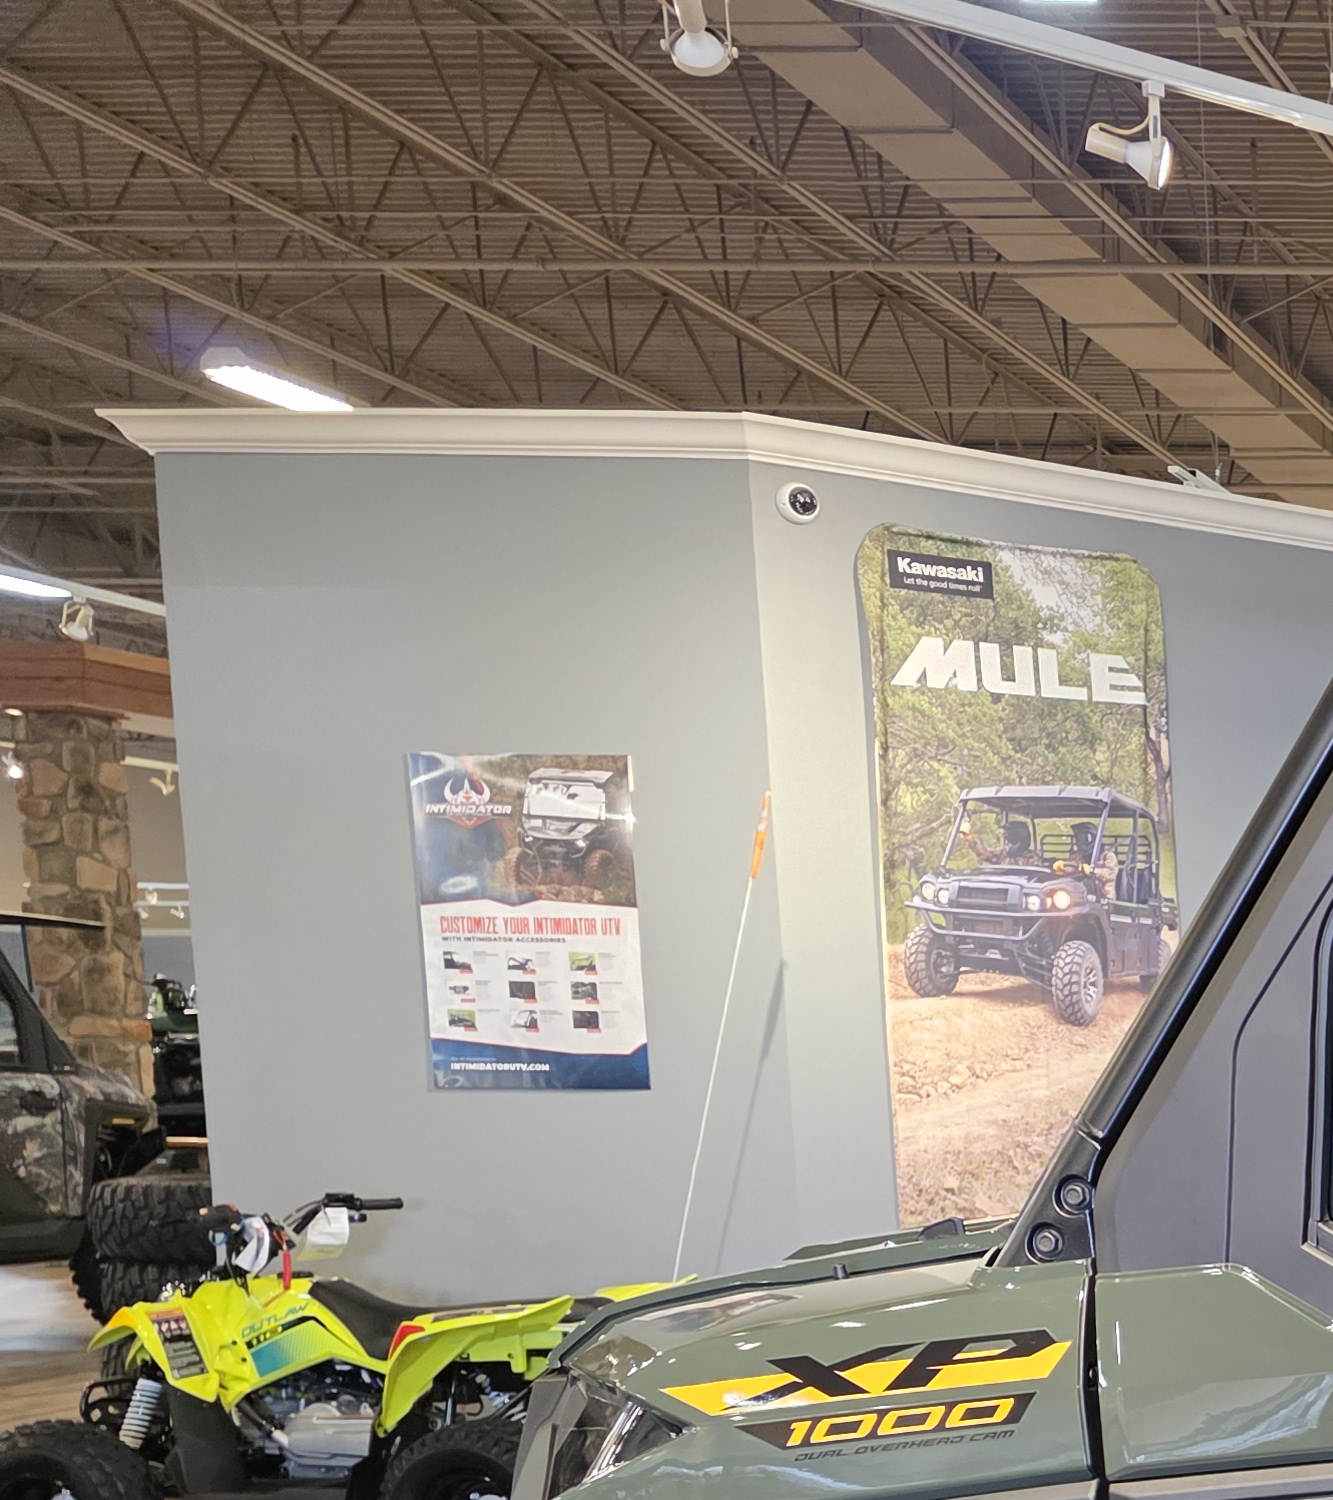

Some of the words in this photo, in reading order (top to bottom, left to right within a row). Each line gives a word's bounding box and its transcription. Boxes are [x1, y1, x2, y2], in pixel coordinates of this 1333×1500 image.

[897, 557, 983, 582] Kawasaki
[904, 576, 915, 585] Let
[916, 578, 928, 586] the
[929, 580, 947, 588] good
[949, 582, 967, 590] times
[890, 636, 1148, 705] MULE
[425, 804, 512, 814] INTIMIDATOR
[440, 915, 499, 935] CUSTOMIZE
[502, 916, 530, 935] YOUR
[533, 916, 597, 936] INTIMIDATOR
[601, 918, 621, 936] UTV
[450, 1063, 550, 1071] INTIMIDATORUTV.COM
[241, 1300, 309, 1338] OUTLAW
[719, 1329, 1060, 1412] XP
[785, 1397, 1015, 1447] 1000
[794, 1449, 850, 1462] DUAL
[854, 1436, 964, 1455] OVERHEAD
[968, 1429, 1015, 1442] CAM
